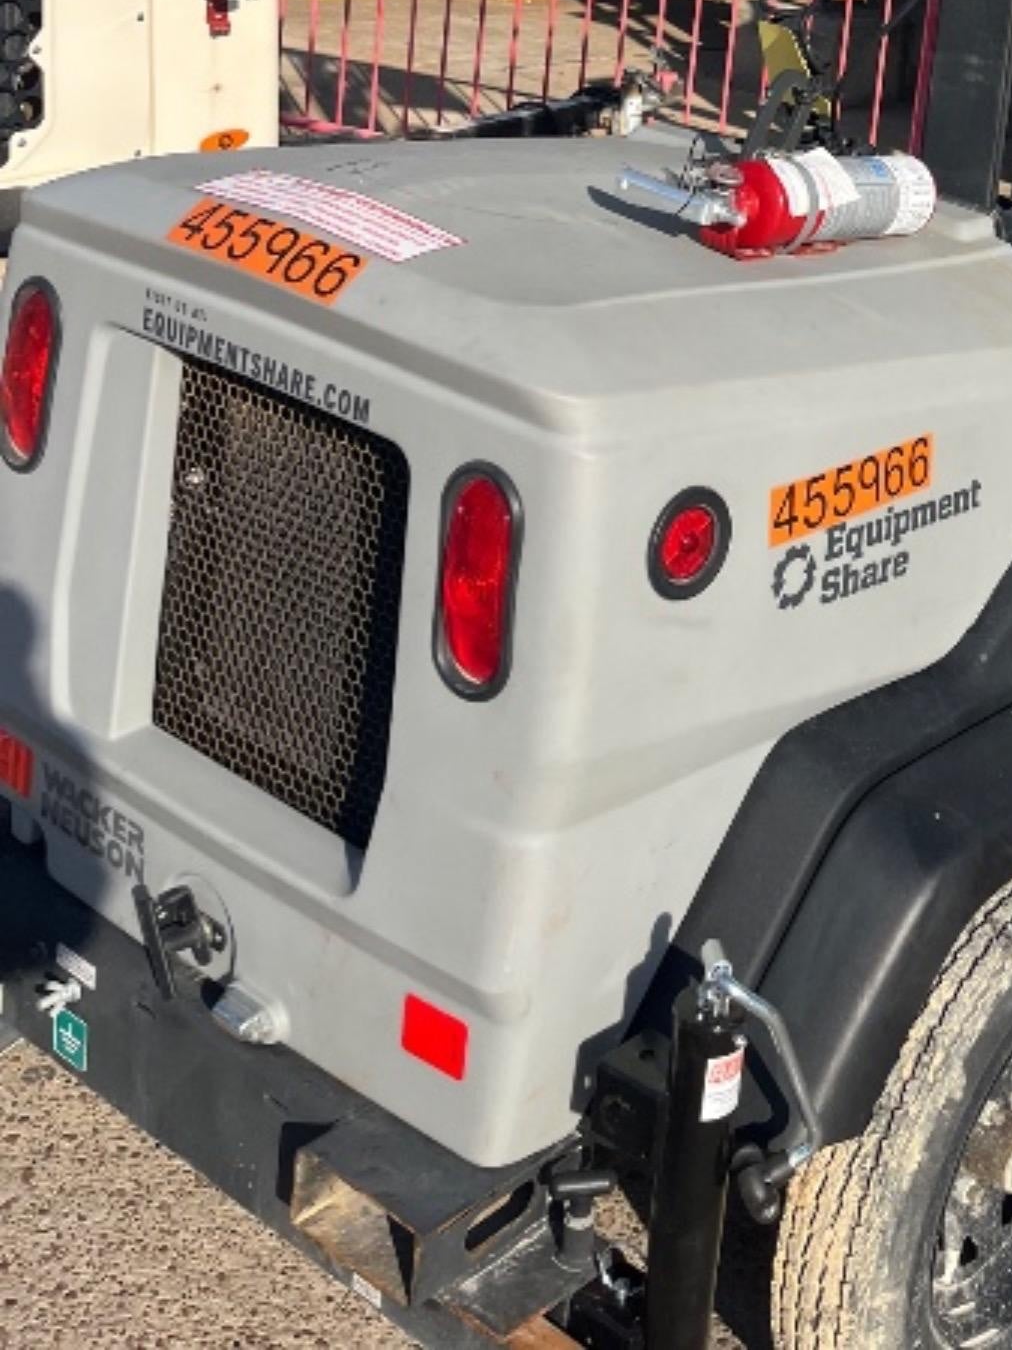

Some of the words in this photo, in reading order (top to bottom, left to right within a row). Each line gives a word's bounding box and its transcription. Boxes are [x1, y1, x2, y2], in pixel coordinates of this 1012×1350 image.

[178, 202, 361, 298] 455966
[142, 307, 370, 424] EQUIPMENTSHARE.COM
[772, 436, 930, 537] 455966
[824, 478, 982, 562] Equipment
[819, 549, 910, 605] Share
[41, 791, 145, 886] NEUSON
[43, 761, 145, 856] WACKER
